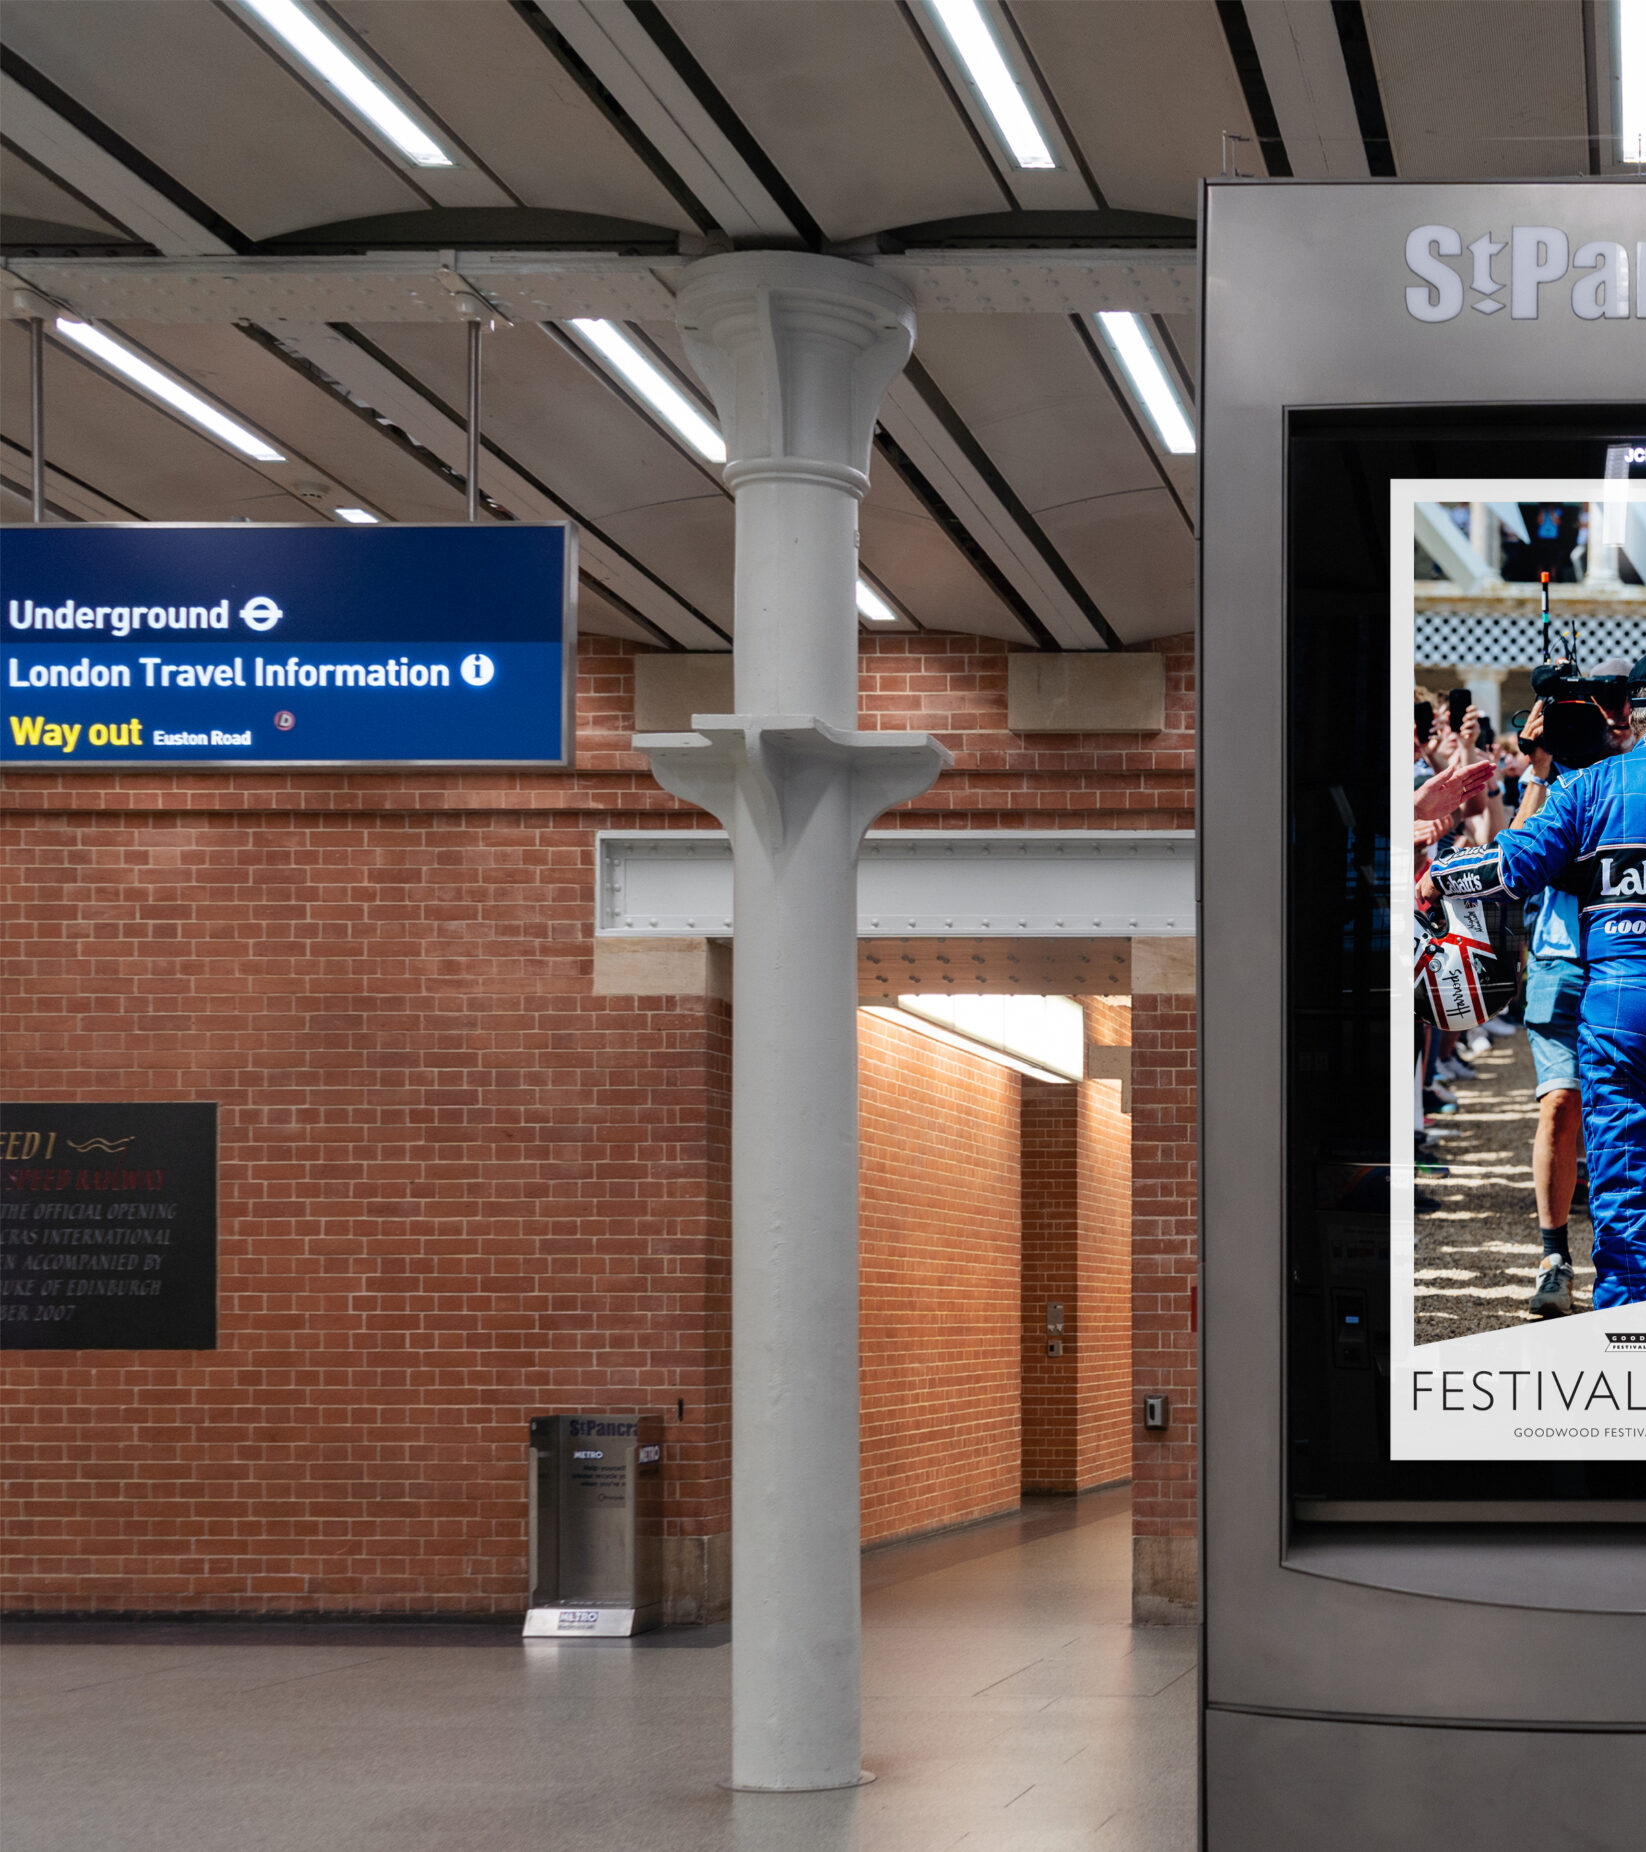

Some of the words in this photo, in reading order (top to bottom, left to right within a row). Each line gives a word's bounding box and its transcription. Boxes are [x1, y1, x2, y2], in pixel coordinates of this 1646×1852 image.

[9, 599, 230, 637] Underground
[9, 657, 131, 687] London
[139, 657, 247, 687] Travel
[255, 657, 450, 687] Information
[9, 716, 80, 753] Way
[88, 718, 143, 746] out
[152, 730, 208, 746] Euston
[210, 730, 252, 746] Road
[1437, 872, 1483, 896] Labatt's
[1442, 968, 1471, 1019] Harrods
[5, 1168, 71, 1191] SPEED
[75, 1157, 167, 1191] RAILWAY
[0, 1203, 28, 1220] THE
[33, 1203, 103, 1220] OFFICIAL
[107, 1203, 180, 1220] OPENING
[42, 1229, 172, 1245] INTERNATIONAL
[23, 1254, 140, 1270] ACCOMPANIED
[143, 1254, 165, 1270] BY
[0, 1279, 35, 1296] UKE
[41, 1279, 63, 1296] OF
[66, 1279, 162, 1296] EDINBURGH
[34, 1305, 76, 1321] 2007
[1513, 1427, 1600, 1438] GOODWOOD
[573, 1450, 604, 1459] METRO
[639, 1445, 660, 1464] METRO
[560, 1611, 598, 1622] METRO
